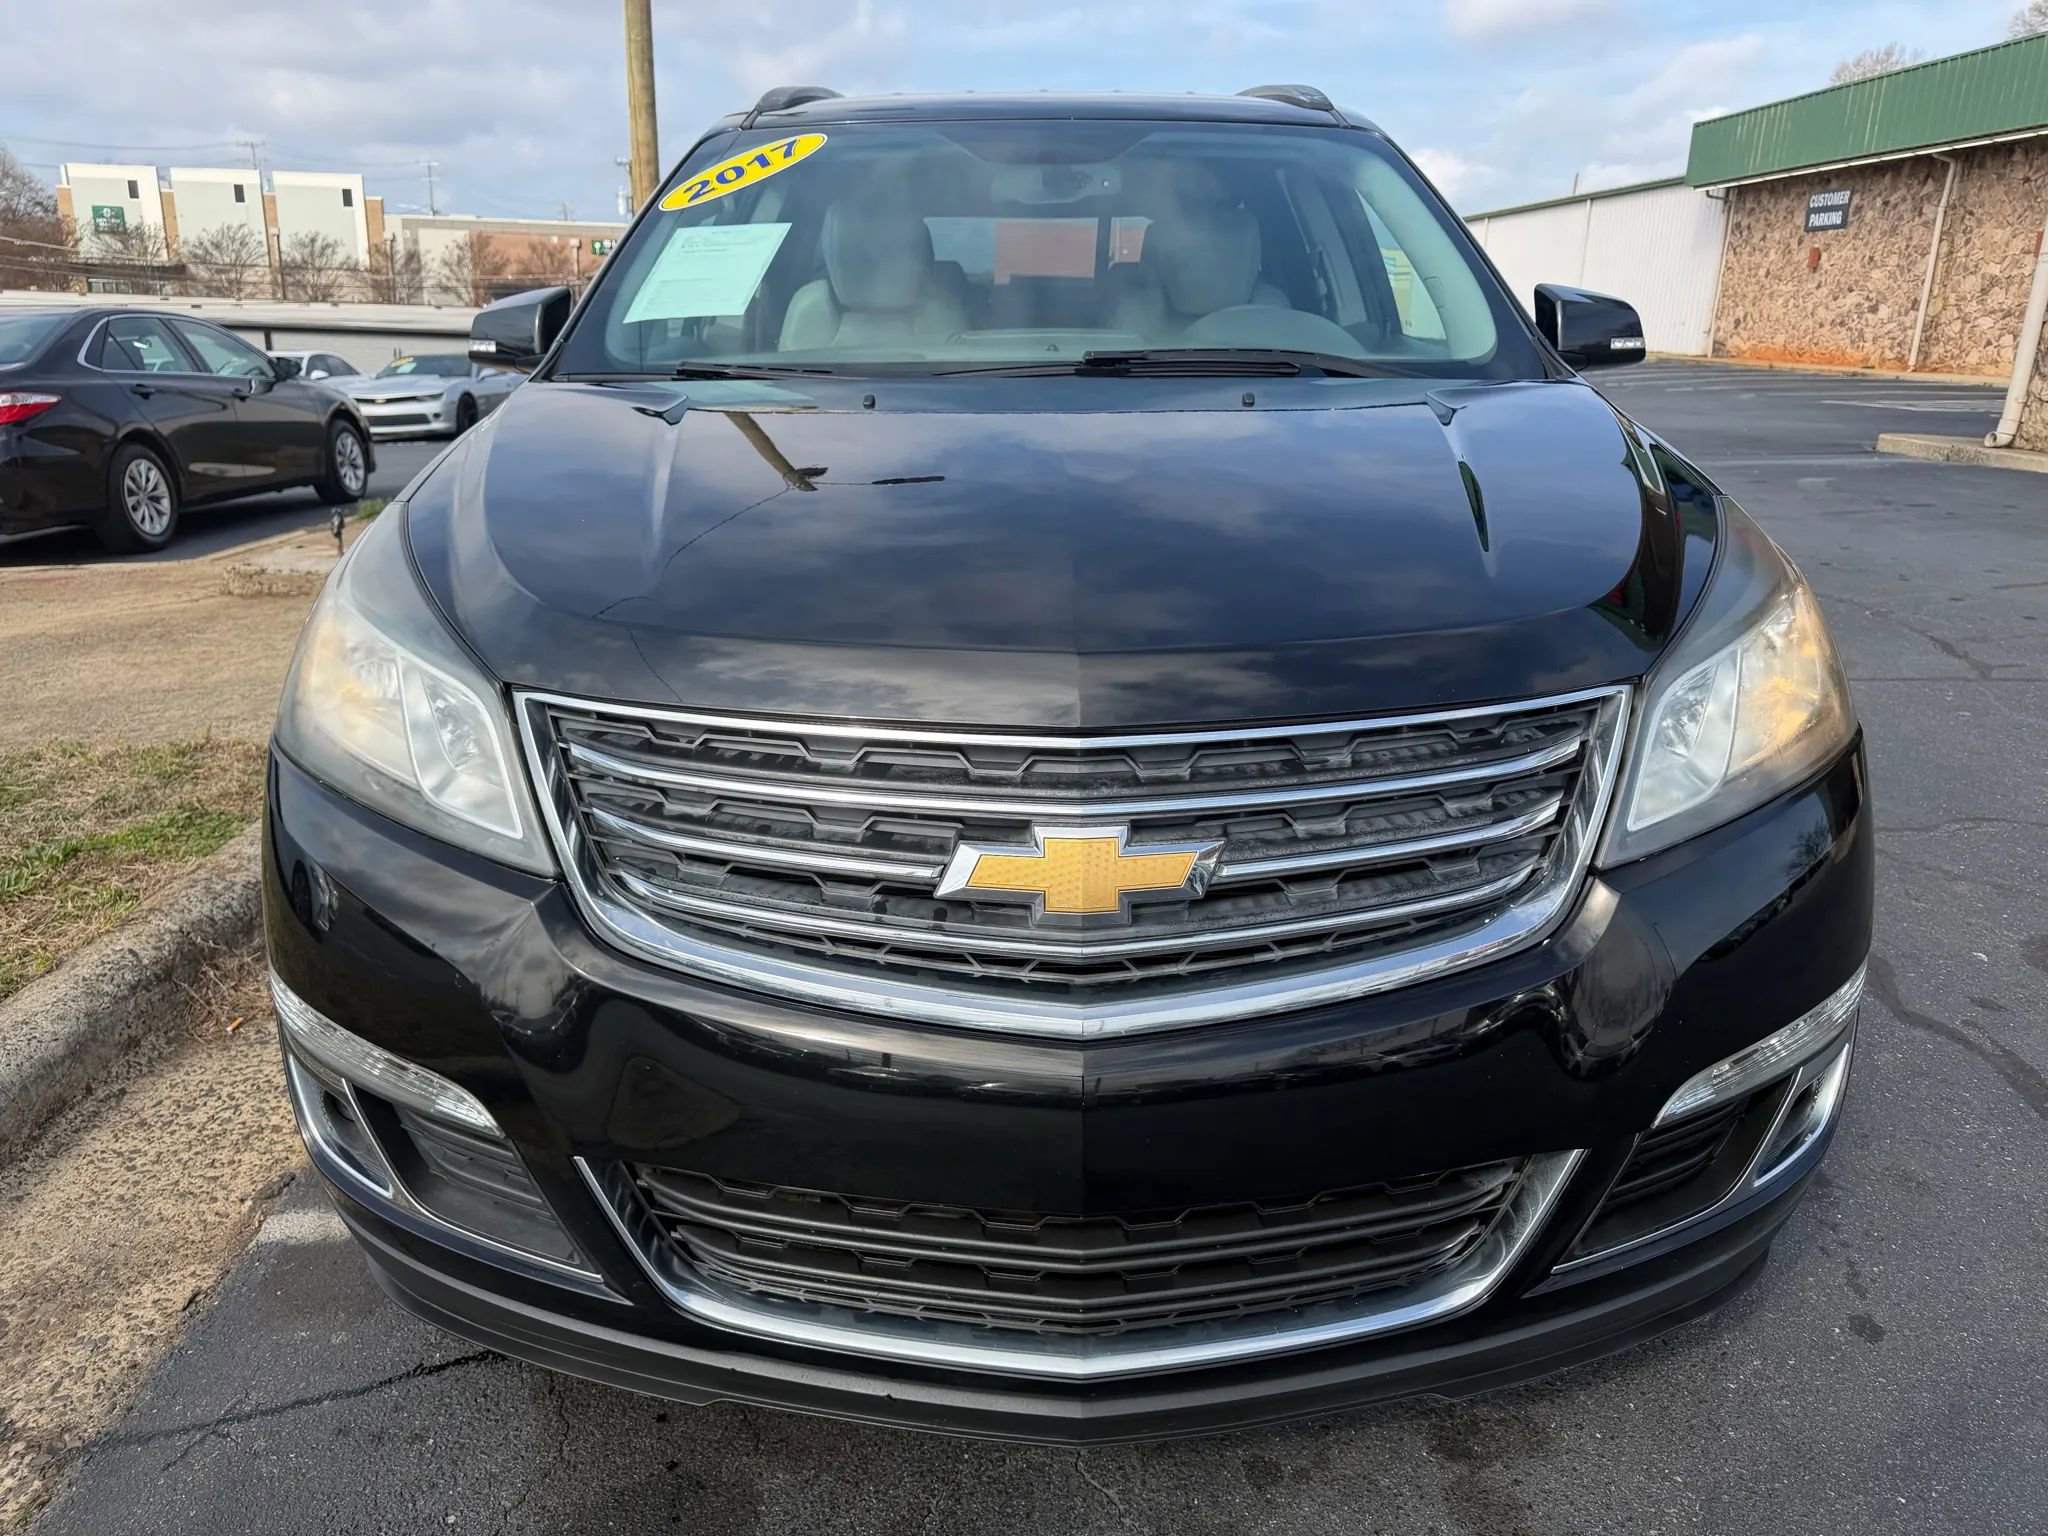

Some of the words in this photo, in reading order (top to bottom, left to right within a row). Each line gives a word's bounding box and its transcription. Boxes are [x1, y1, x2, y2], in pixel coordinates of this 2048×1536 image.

[684, 139, 799, 203] 2017
[1810, 190, 1850, 208] CUSTOMER
[1808, 211, 1842, 227] PARKING
